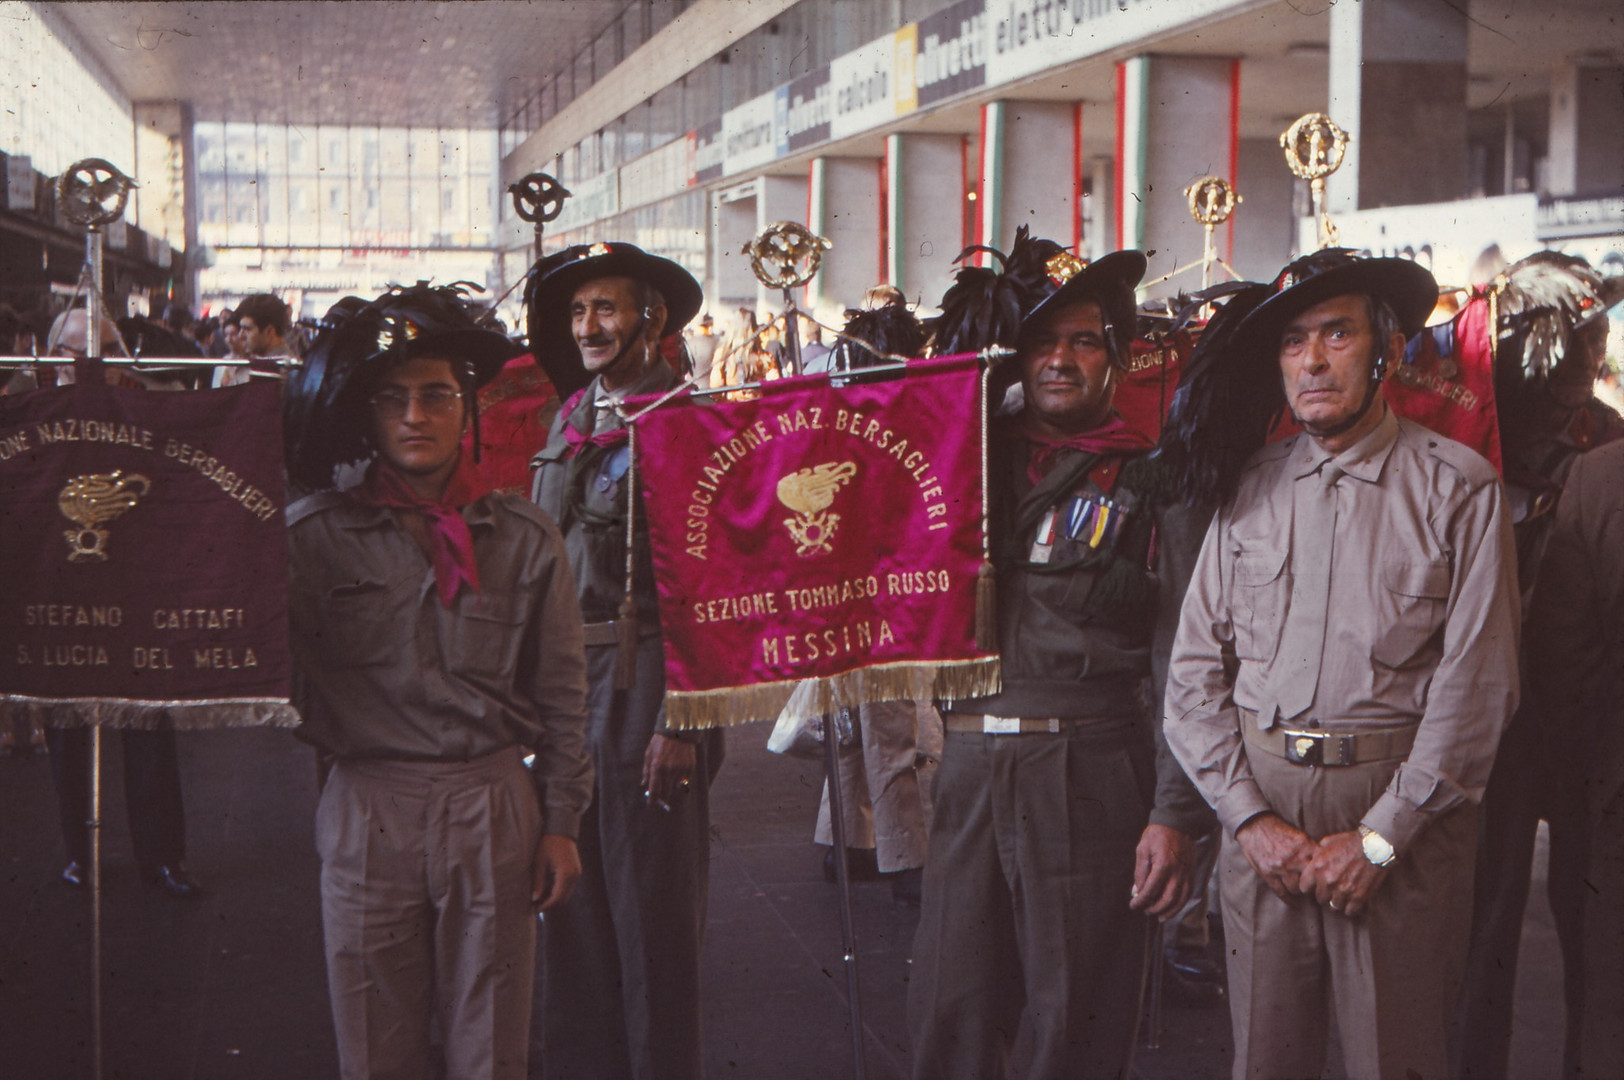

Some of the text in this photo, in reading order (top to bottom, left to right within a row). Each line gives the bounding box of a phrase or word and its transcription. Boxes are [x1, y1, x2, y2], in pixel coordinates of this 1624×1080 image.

[37, 418, 154, 451] NAZIONALE
[164, 438, 279, 522] BERSAGLIERI
[686, 420, 773, 560] ASSOCIAZIONE
[836, 409, 949, 531] BERSAGLIERI
[25, 604, 244, 630] STEFANO CATTAFI
[694, 569, 951, 624] SEZIONE TOMMASO RUSSO
[44, 645, 109, 666] LUCIA
[134, 647, 173, 669] DEL
[194, 648, 259, 670] MELA
[762, 620, 895, 665] MESSINA
